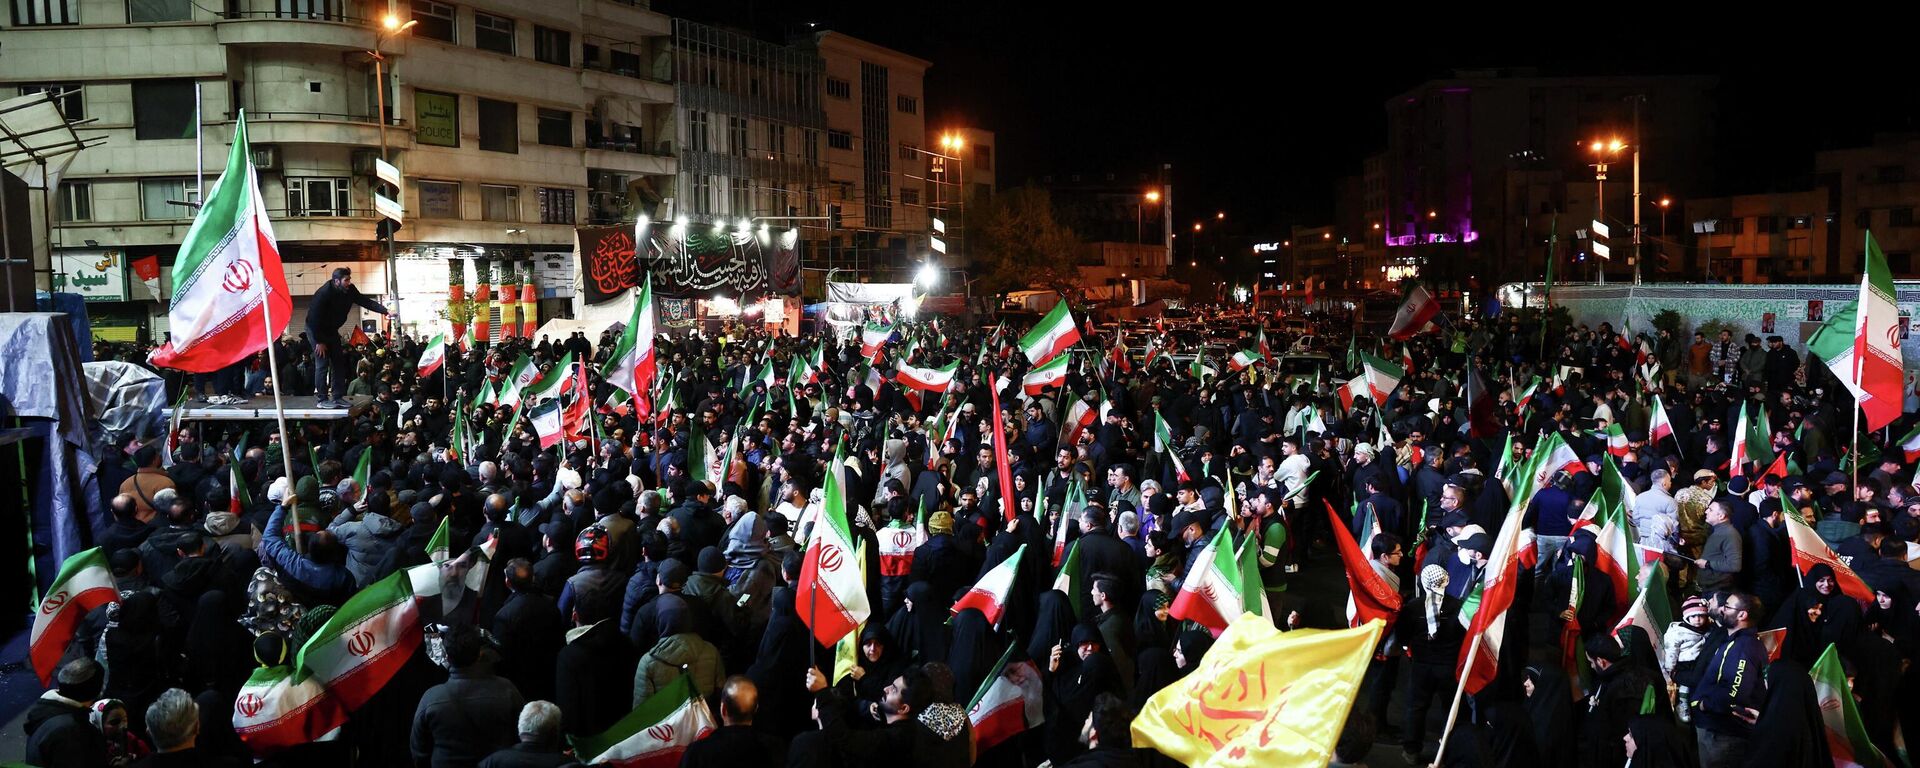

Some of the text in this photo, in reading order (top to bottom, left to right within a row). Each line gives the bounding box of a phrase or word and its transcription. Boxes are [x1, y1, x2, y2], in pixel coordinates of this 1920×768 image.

[419, 126, 452, 139] POLICE
[95, 249, 118, 272] آش
[71, 269, 108, 292] سید
[1729, 659, 1747, 698] GIVOVA
